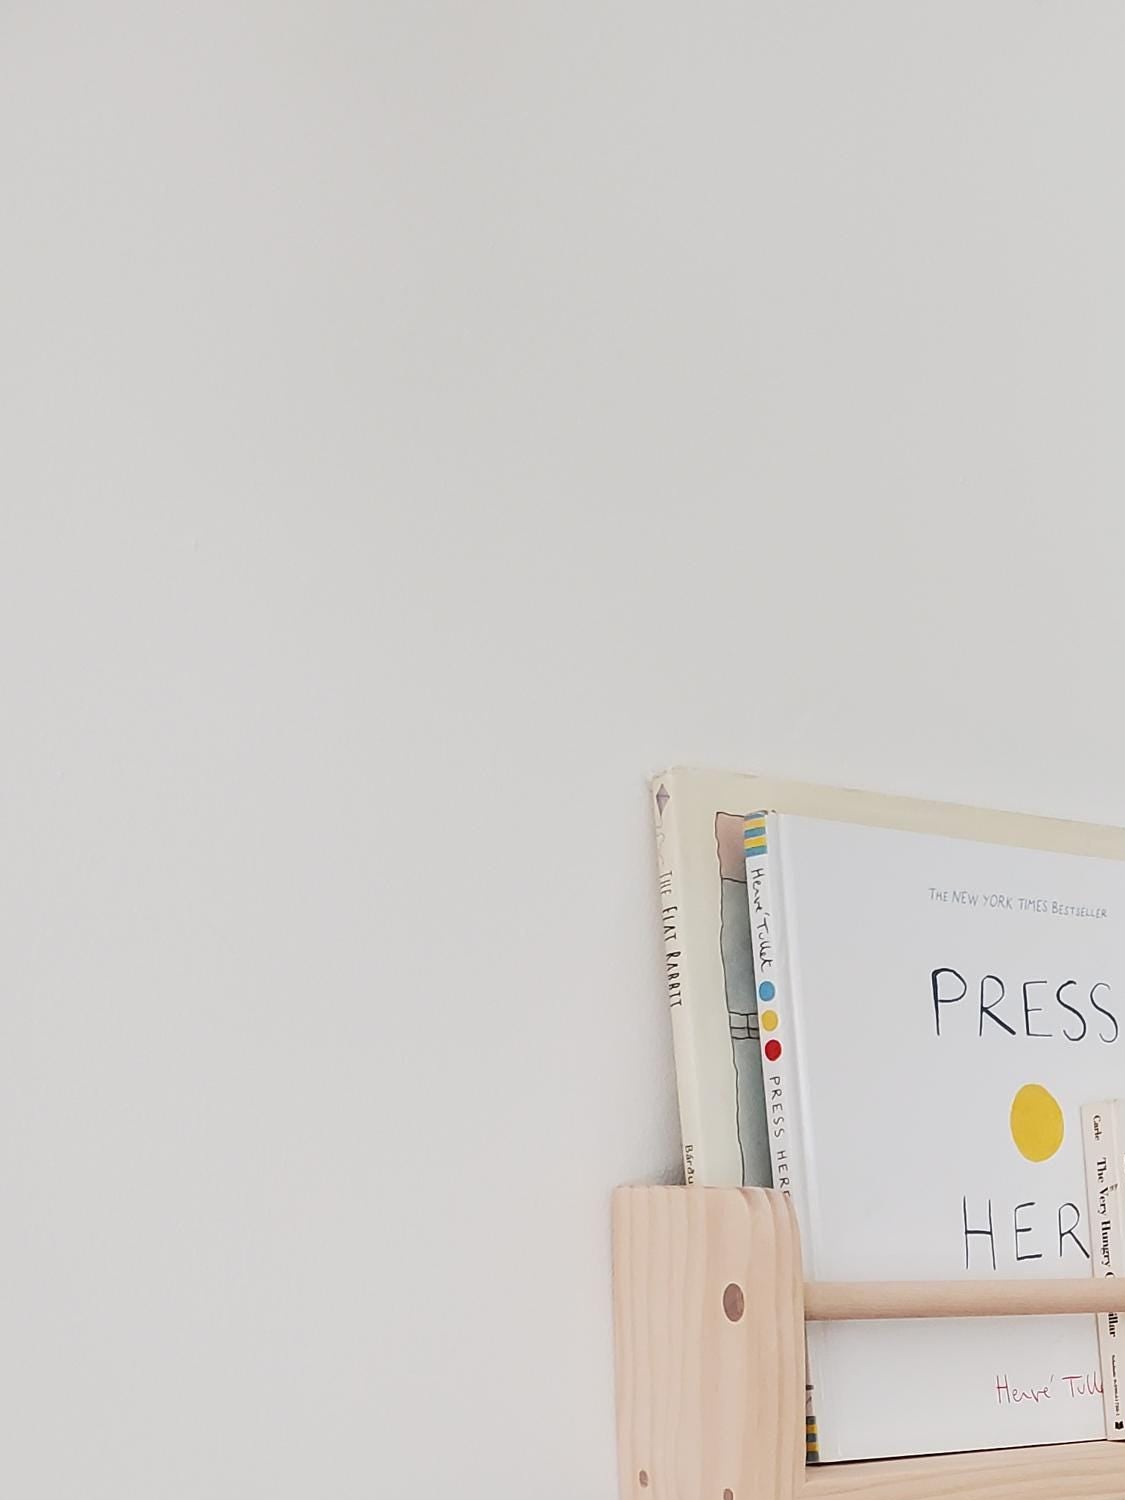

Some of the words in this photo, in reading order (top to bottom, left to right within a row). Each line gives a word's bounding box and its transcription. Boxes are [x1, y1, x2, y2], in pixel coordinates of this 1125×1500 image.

[929, 888, 948, 902] THE
[952, 891, 979, 906] NEW
[983, 894, 1013, 909] YORK
[1018, 898, 1048, 913] TIMES
[1052, 901, 1107, 918] BESTSELLER
[932, 967, 1118, 1043] PRESS
[769, 1076, 785, 1138] PRESS
[1092, 1114, 1102, 1141] Carle
[1097, 1157, 1107, 1183] The
[1098, 1186, 1108, 1215] Very
[963, 1195, 1089, 1270] HER
[1101, 1220, 1112, 1267] Hungry
[1062, 1371, 1104, 1398] Tull
